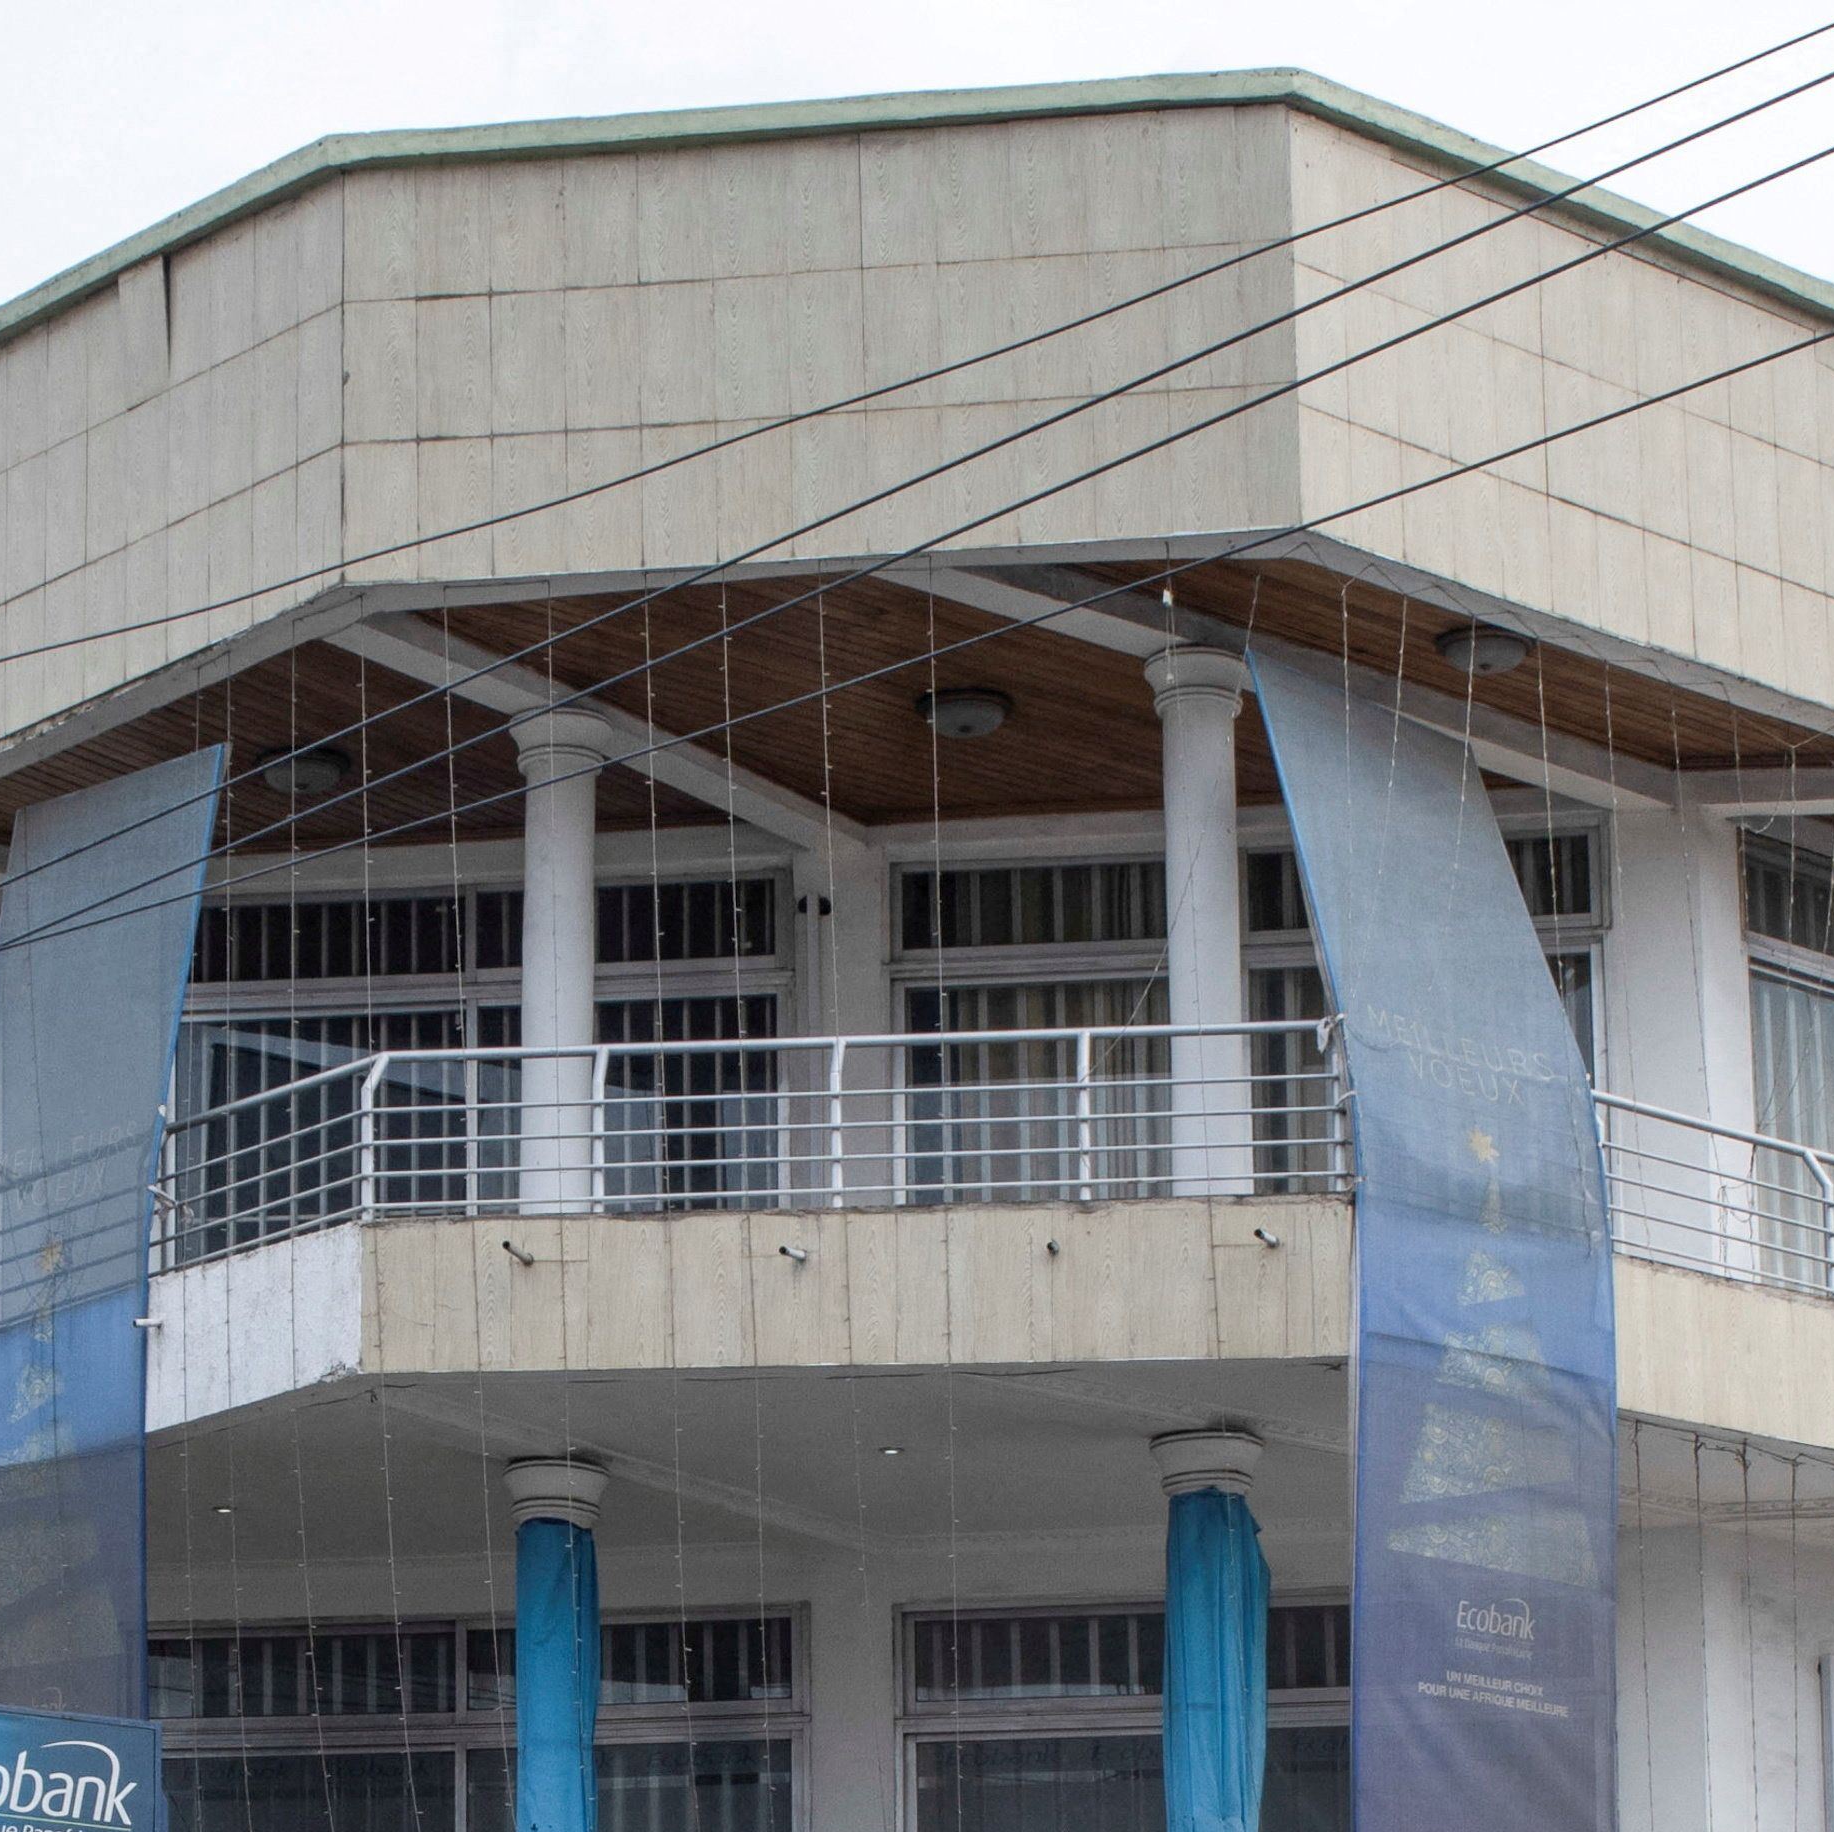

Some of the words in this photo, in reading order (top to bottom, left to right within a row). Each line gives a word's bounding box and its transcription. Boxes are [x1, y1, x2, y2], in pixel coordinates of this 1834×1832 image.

[1367, 1005, 1555, 1081] MEILLEURS
[1408, 1051, 1524, 1105] VOEUX
[1457, 1598, 1536, 1640] Ecobank
[1418, 1681, 1447, 1697] POUR
[1448, 1687, 1471, 1700] UNE
[1472, 1691, 1515, 1708] AFRIQUE
[1516, 1698, 1568, 1718] MEILLEURE
[1446, 1670, 1462, 1683] UN
[1463, 1673, 1512, 1692] MEILLEUR
[1513, 1682, 1544, 1697] CHOIX
